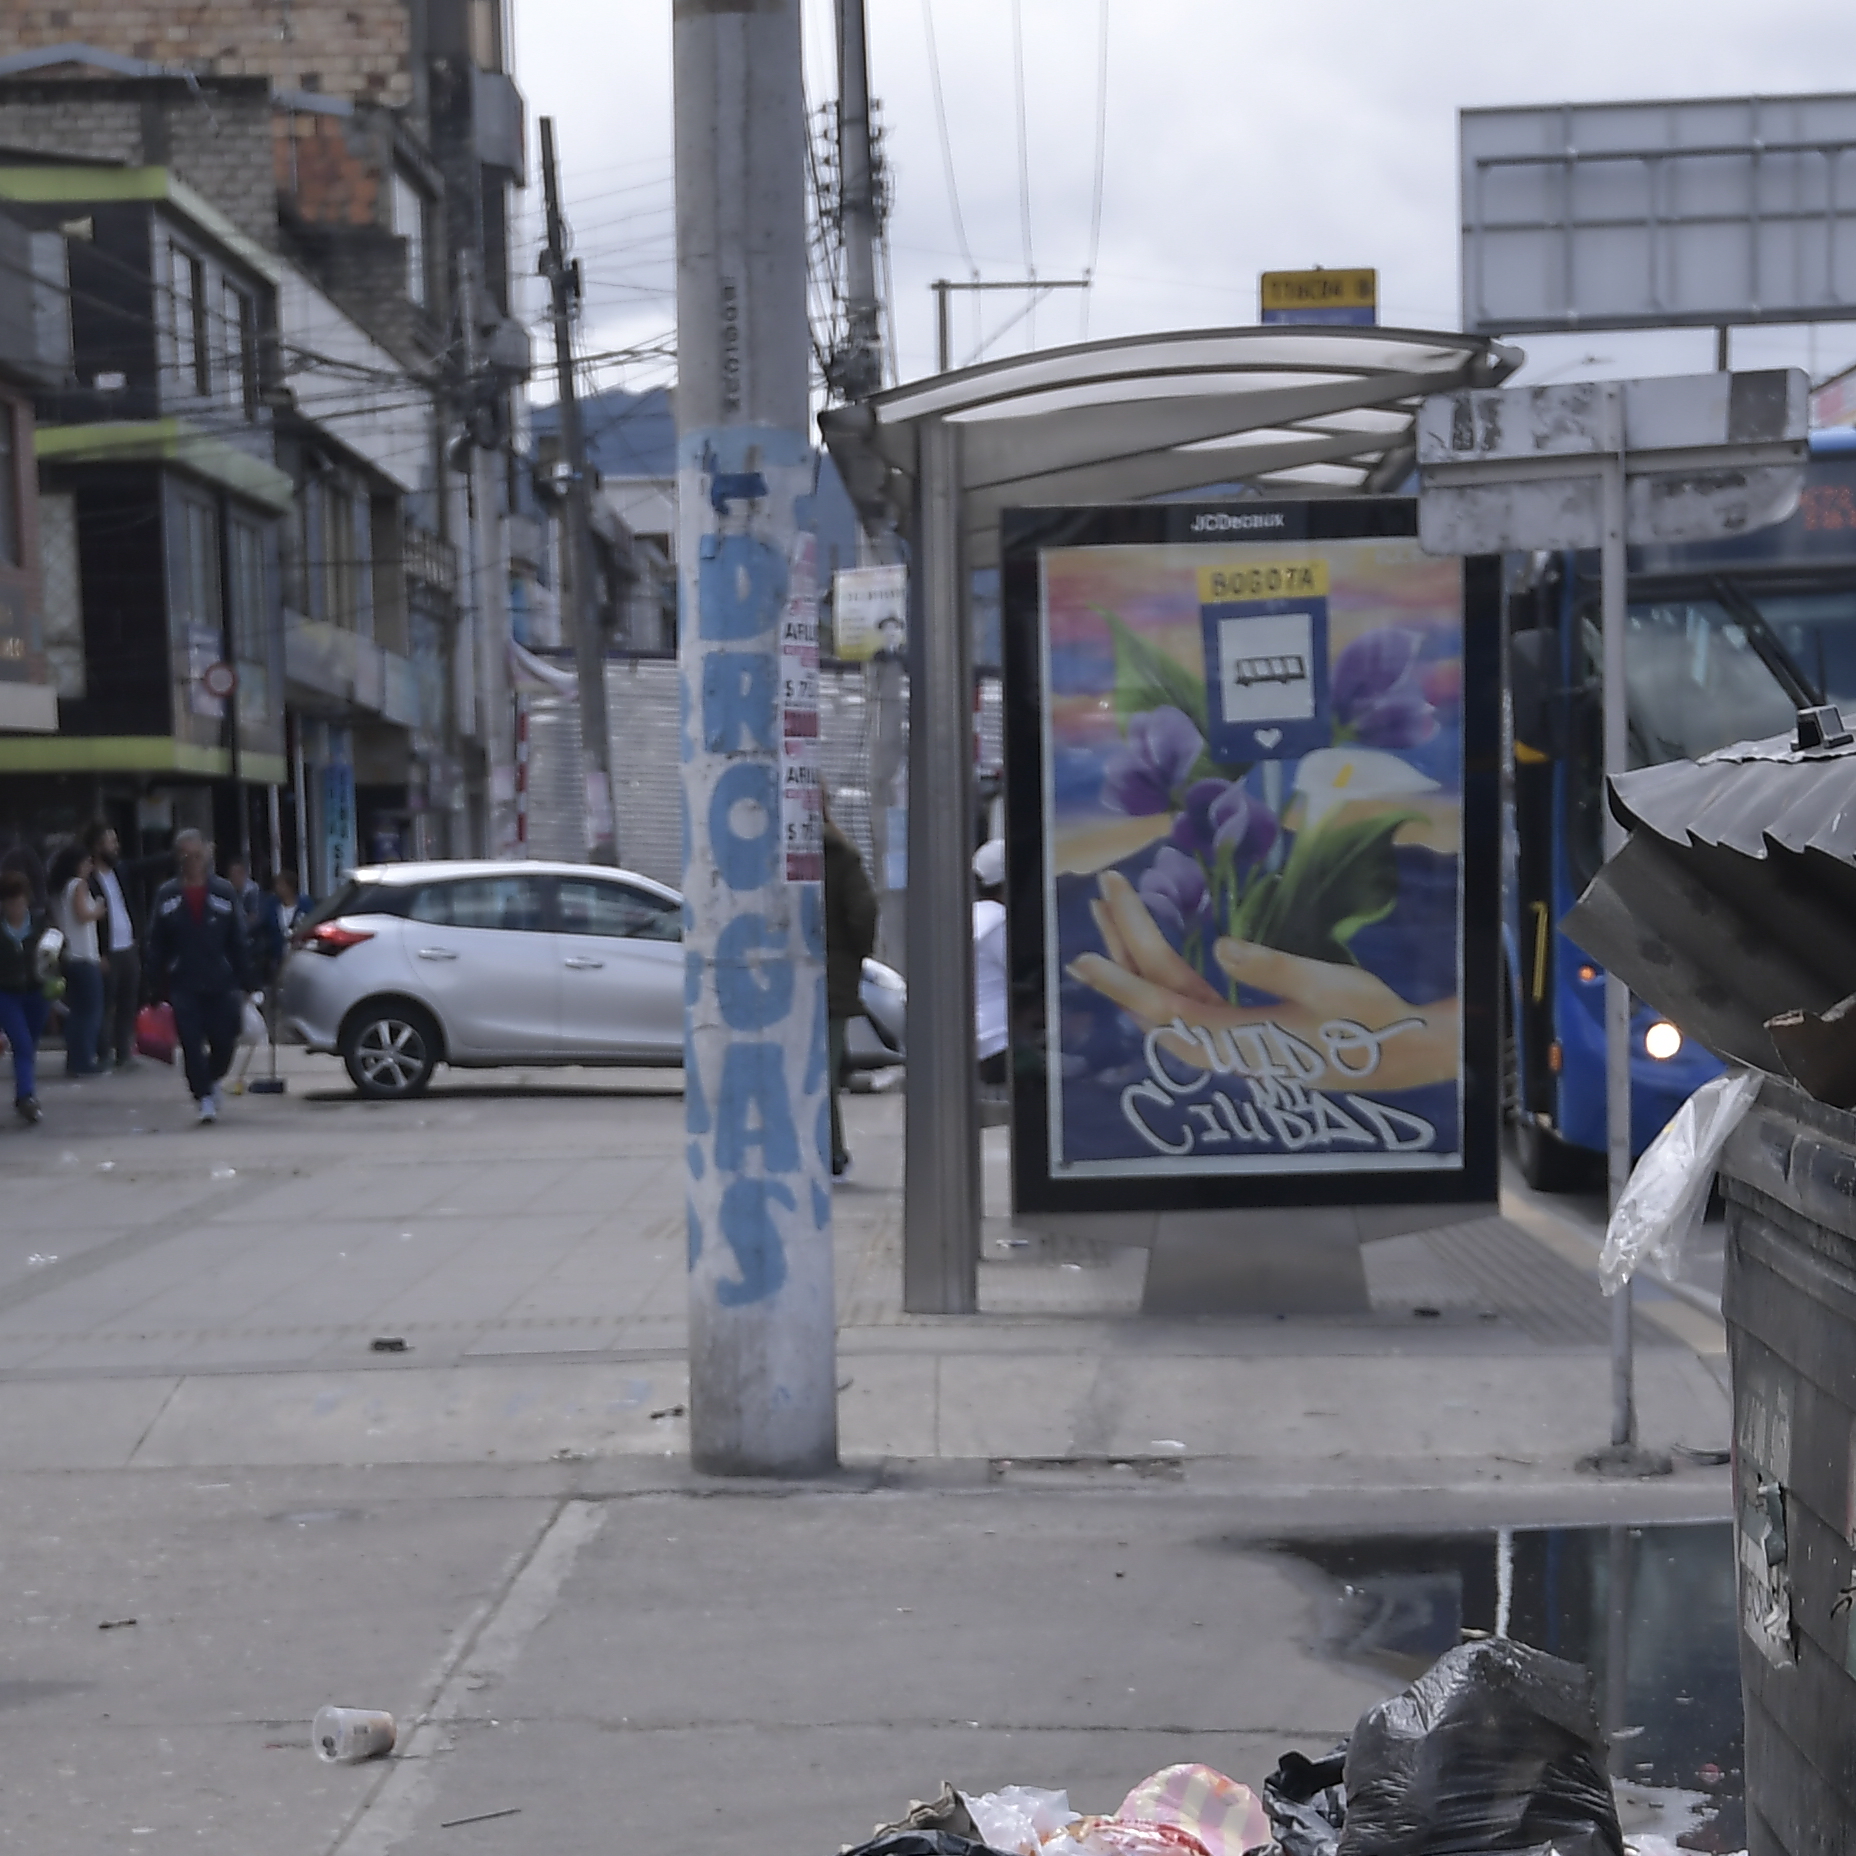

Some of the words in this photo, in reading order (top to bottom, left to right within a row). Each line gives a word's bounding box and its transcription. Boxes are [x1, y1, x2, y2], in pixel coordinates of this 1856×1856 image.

[1190, 511, 1285, 532] JCDecaux
[699, 534, 800, 1306] DROGAS
[1143, 1017, 1427, 1093] CUIDO
[1120, 1077, 1437, 1155] CIUDAD
